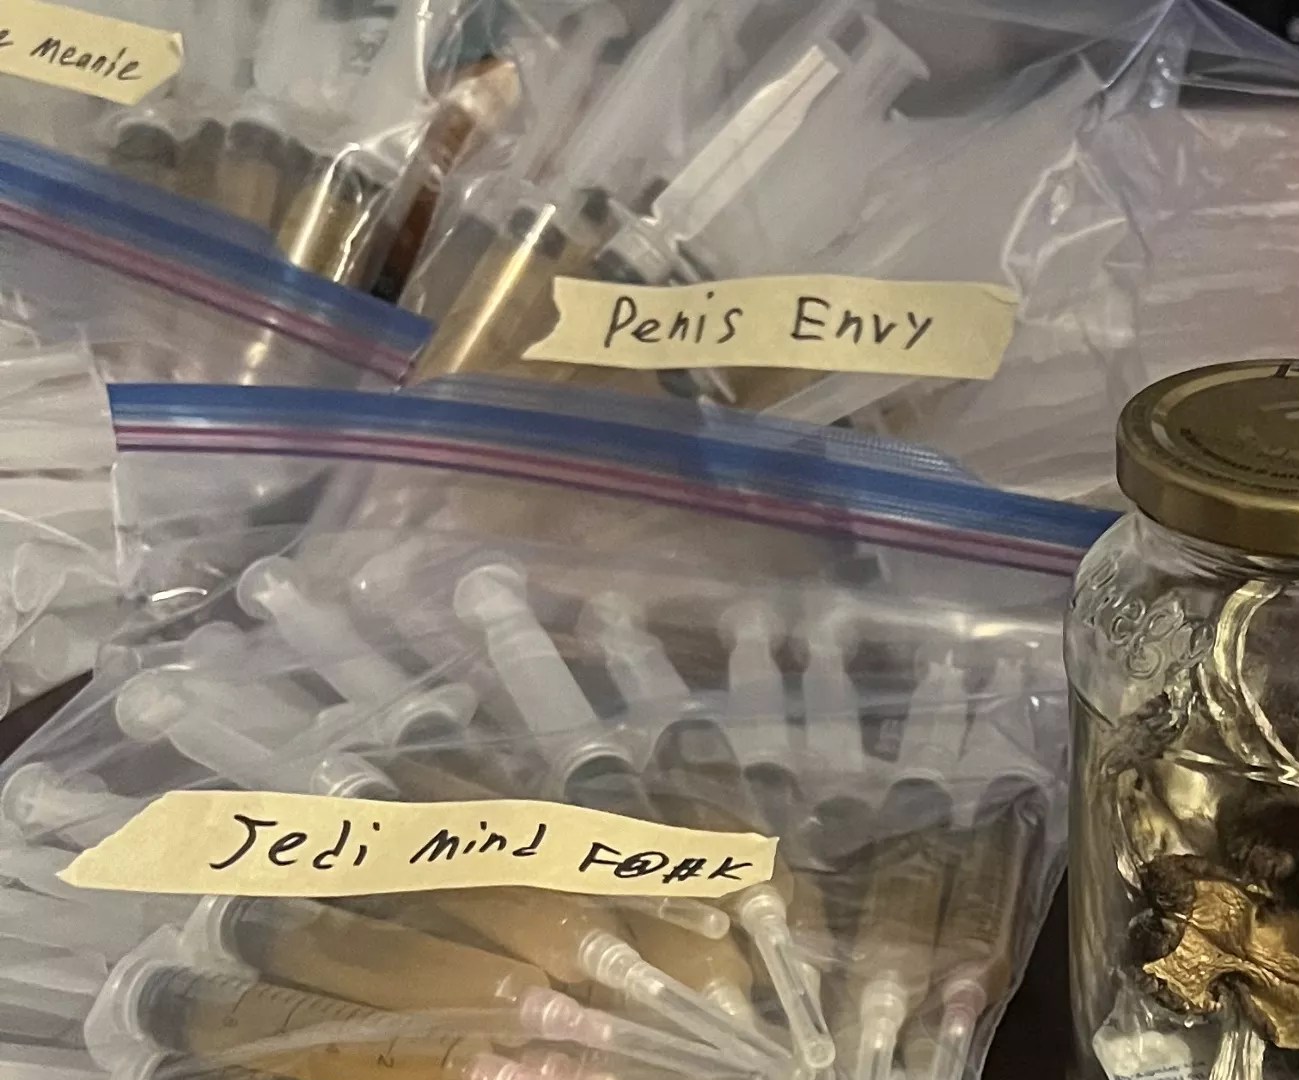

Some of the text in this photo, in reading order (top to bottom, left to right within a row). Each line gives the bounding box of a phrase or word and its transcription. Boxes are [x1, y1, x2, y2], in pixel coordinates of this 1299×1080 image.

[29, 36, 143, 81] Meanie
[604, 290, 934, 350] Penis Envy
[210, 815, 381, 869] Jedi
